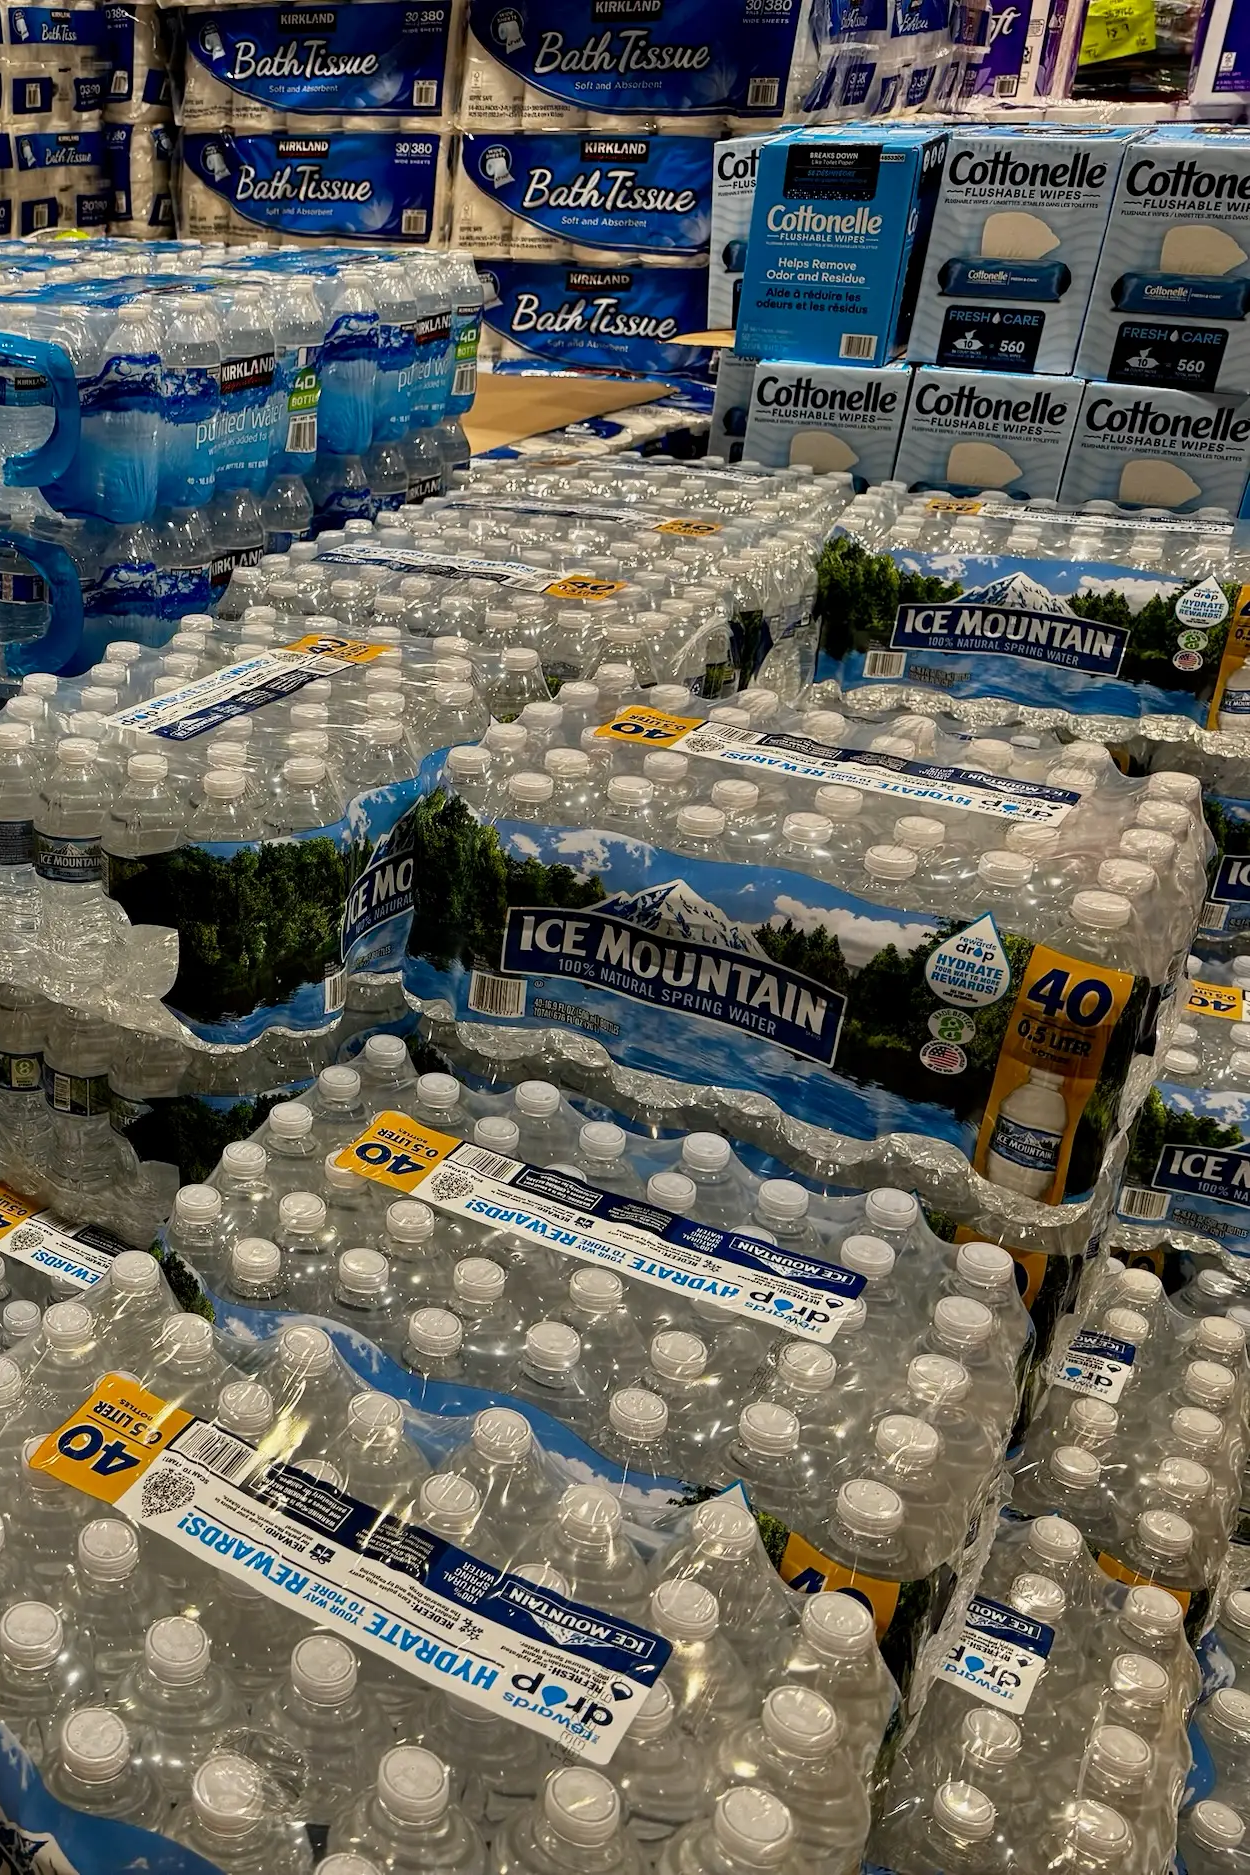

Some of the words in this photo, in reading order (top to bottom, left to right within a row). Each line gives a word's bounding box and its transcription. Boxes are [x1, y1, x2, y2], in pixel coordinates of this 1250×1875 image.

[279, 12, 336, 26] KIRKLAND
[763, 0, 792, 12] 380
[616, 29, 710, 73] Tissue
[278, 140, 329, 152] KIRKLAND
[584, 141, 647, 155] KIRKLAND
[836, 152, 859, 160] DOWN
[297, 164, 373, 202] Tissue
[948, 150, 1109, 189] Cottonelle
[523, 168, 601, 209] Bath
[965, 187, 1035, 199] FLUSHABLE
[1039, 188, 1081, 201] WIPES
[767, 204, 884, 235] Cottonelle
[1143, 199, 1222, 212] FLUSHABLE
[812, 258, 857, 271] Remove
[822, 273, 866, 284] Residue
[569, 273, 630, 286] KIRKLAND
[511, 294, 587, 332] Bath
[591, 297, 677, 338] Tissue
[459, 328, 477, 343] 40
[221, 356, 275, 382] KIRKLAND
[294, 374, 317, 390] 40
[756, 375, 899, 415] Cottonelle
[916, 378, 1069, 427] Cottonelle
[250, 402, 284, 429] water
[931, 416, 1000, 432] FLUSHABLE
[1086, 398, 1250, 442] Cottonelle
[1102, 433, 1177, 449] FLUSHABLE
[1181, 440, 1225, 452] WIPES
[904, 607, 949, 635] ICE
[956, 608, 1115, 658] MOUNTAIN
[927, 635, 955, 648] 100%
[957, 637, 1001, 651] NATURAL
[1004, 642, 1044, 658] SPRING
[1047, 650, 1079, 667] WATER
[611, 722, 678, 741] 40
[719, 750, 825, 778] REWARDS!
[874, 781, 972, 807] HYDRATE
[967, 772, 1040, 794] MOUNTAIN
[981, 798, 1054, 820] drop
[40, 854, 53, 865] ICE
[53, 855, 101, 869] MOUNTAIN
[346, 880, 370, 935] ICE
[371, 858, 414, 907] MO
[374, 892, 414, 921] NATURAL
[959, 934, 997, 951] rewards
[520, 914, 591, 957] ICE
[596, 924, 827, 1034] MOUNTAIN
[936, 953, 1004, 980] HYDRATE
[931, 970, 998, 996] REWARDS!
[599, 967, 655, 999] NATURAL
[661, 988, 723, 1016] SPRING
[729, 1005, 777, 1036] WATER
[1027, 967, 1113, 1028] 40
[1016, 1017, 1046, 1044] 0.5
[1048, 1031, 1092, 1058] LITER
[377, 1128, 413, 1151] LITER
[411, 1143, 439, 1159] 0.5
[398, 1127, 428, 1144] BOTTLES
[1009, 1138, 1053, 1160] MOUNTAIN
[355, 1142, 426, 1175] 40
[1169, 1150, 1228, 1182] ICE
[1197, 1181, 1229, 1197] 100%
[7, 1204, 28, 1217] 0.5
[464, 1198, 578, 1247] REWARDS!
[578, 1238, 609, 1253] MORE
[30, 1249, 100, 1286] EWARDS!
[739, 1241, 821, 1275] MOUNTAIN
[820, 1267, 850, 1285] ICE
[627, 1257, 741, 1298] HYDRATE
[749, 1290, 831, 1325] drop
[92, 1400, 135, 1428] LITER
[56, 1422, 143, 1477] 40
[192, 1471, 210, 1485] SCAN
[176, 1512, 311, 1596] REWARDS!
[309, 1582, 349, 1604] MORE
[443, 1570, 486, 1598] NATURAL
[507, 1587, 613, 1640] MOUNTAIN
[610, 1632, 647, 1654] ICE
[969, 1603, 1008, 1623] MOU
[1008, 1618, 1035, 1636] ICE
[362, 1611, 500, 1691] HYDRATE
[948, 1645, 1022, 1688] drop
[944, 1663, 1009, 1699] reward
[511, 1672, 614, 1727] drop
[502, 1690, 595, 1744] rewards
